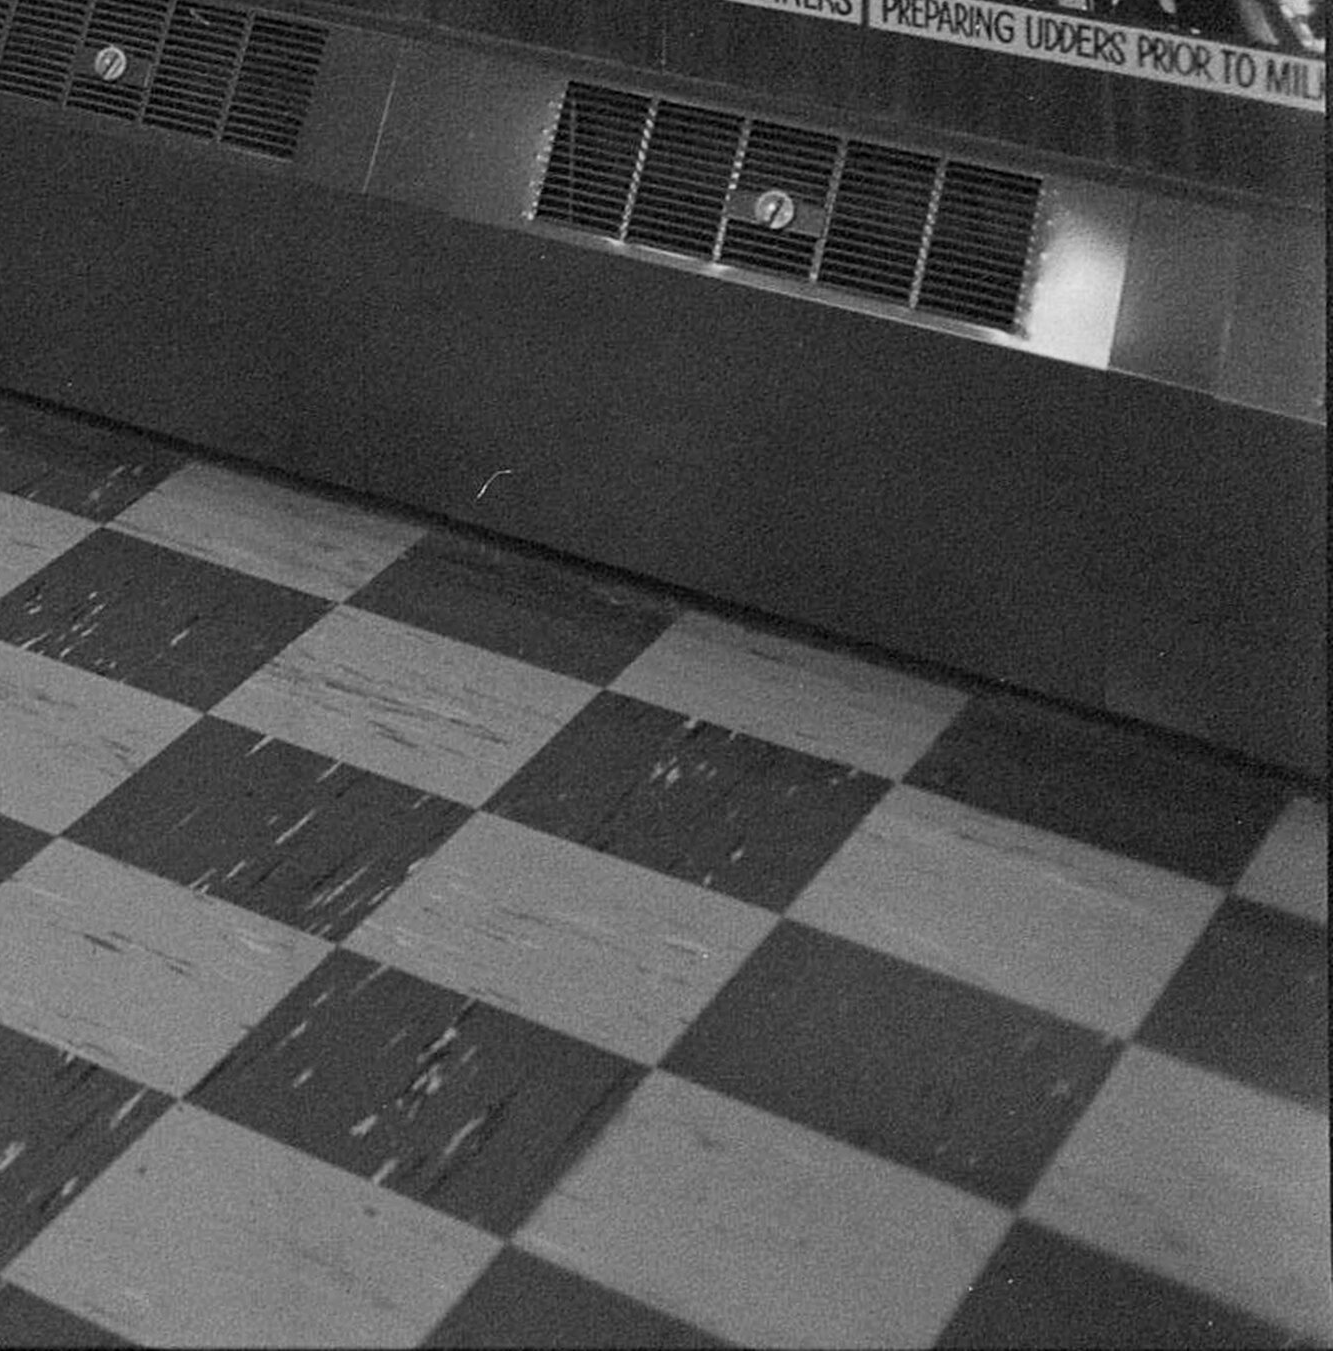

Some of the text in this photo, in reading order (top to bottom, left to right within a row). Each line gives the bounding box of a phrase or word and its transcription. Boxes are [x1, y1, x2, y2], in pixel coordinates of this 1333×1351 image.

[1025, 17, 1126, 66] UDDERS
[1137, 31, 1215, 82] PRIOR
[1221, 49, 1256, 88] TO
